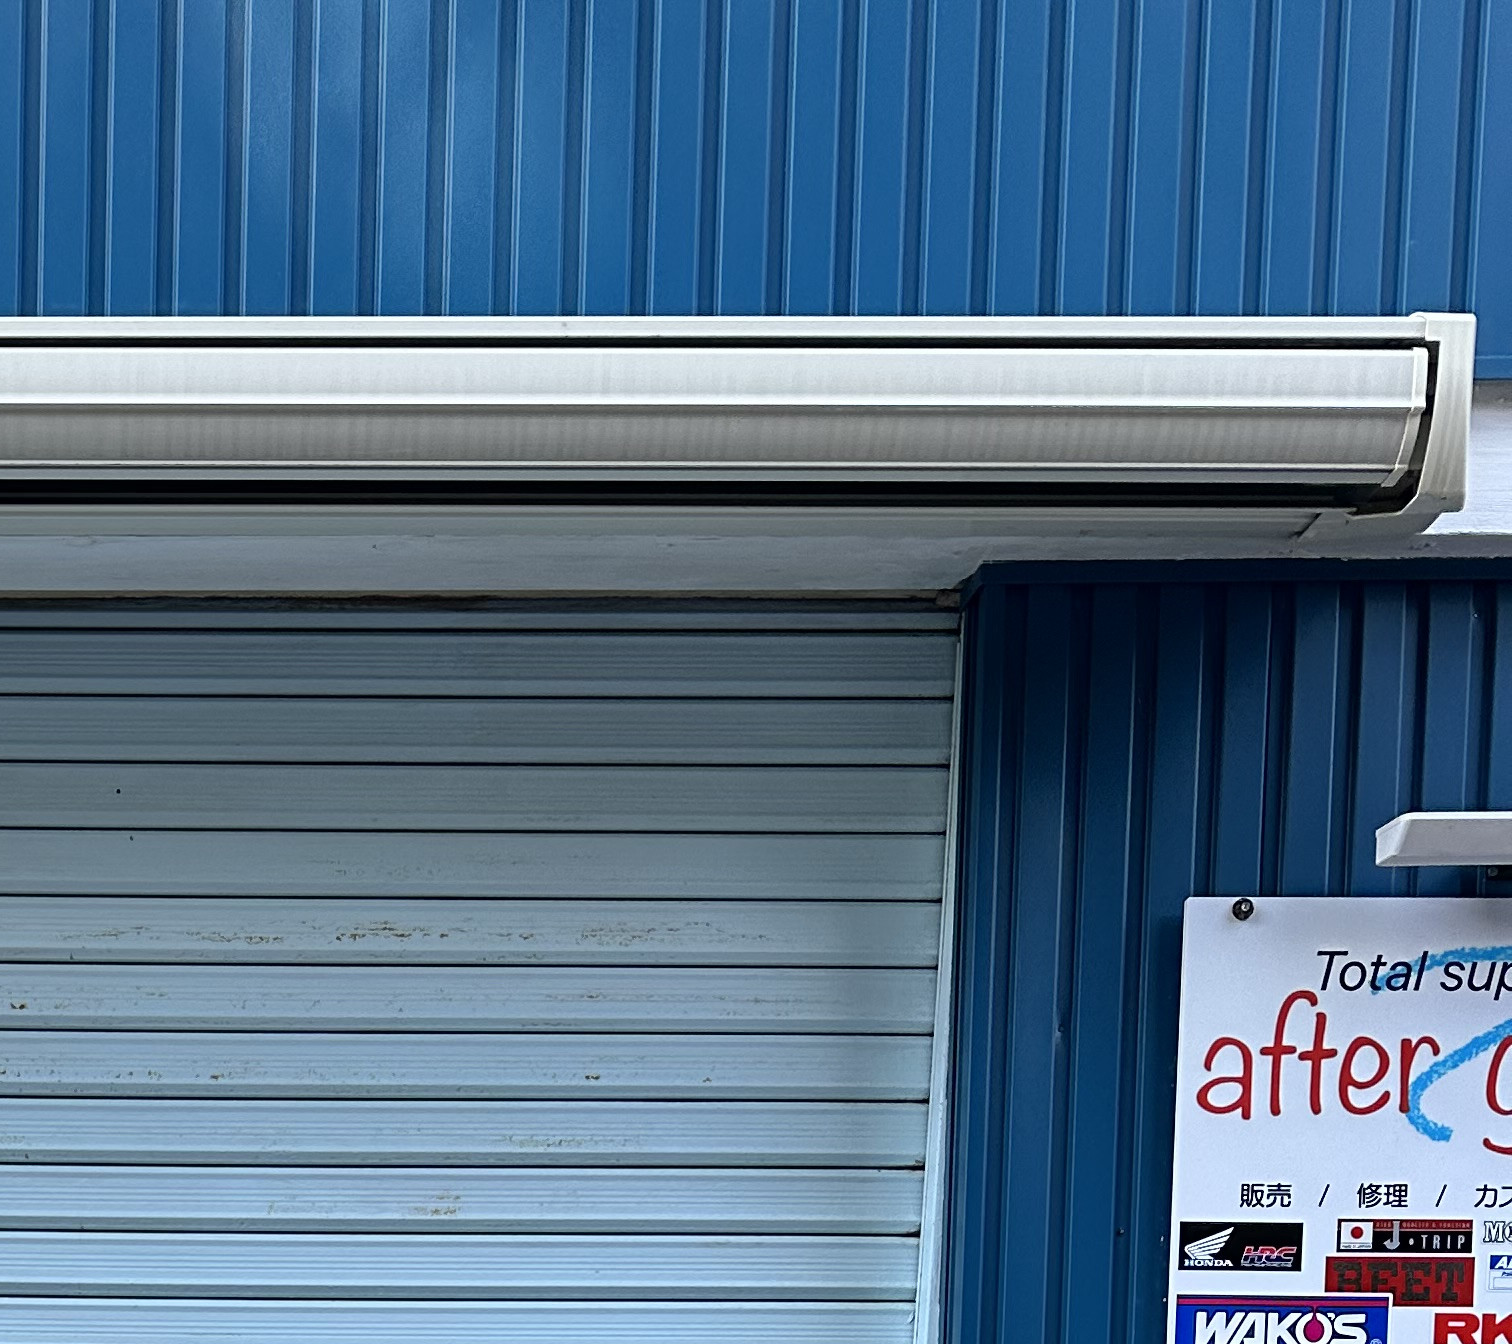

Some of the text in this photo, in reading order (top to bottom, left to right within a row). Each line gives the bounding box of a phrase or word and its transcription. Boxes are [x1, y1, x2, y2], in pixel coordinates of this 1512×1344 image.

[1317, 951, 1512, 1001] Total sup
[1196, 990, 1440, 1120] after
[1240, 1183, 1292, 1208] 販売
[1357, 1183, 1409, 1208] 修理
[1184, 1259, 1234, 1267] HONDA
[1333, 1261, 1465, 1303] BEET
